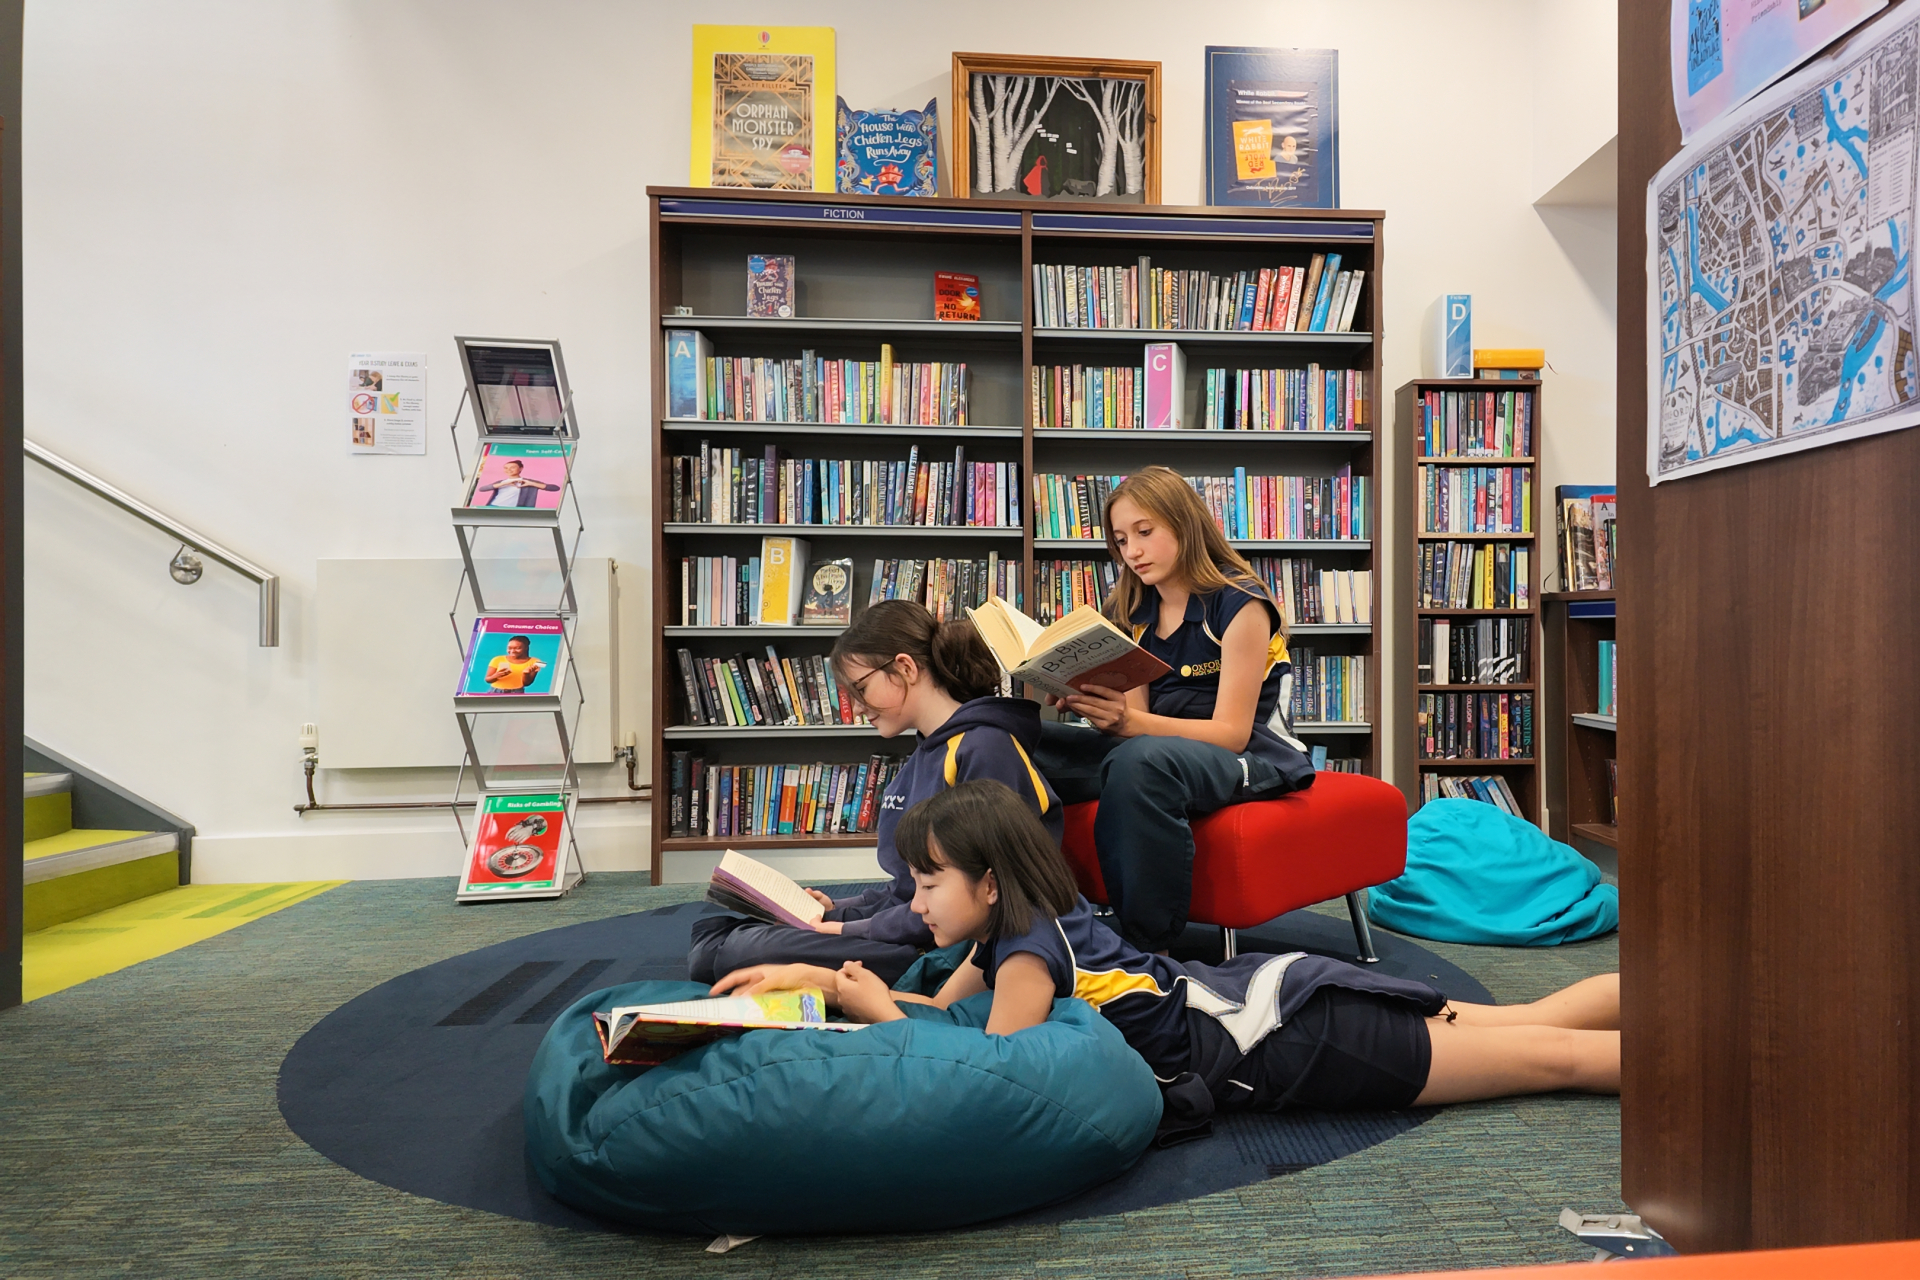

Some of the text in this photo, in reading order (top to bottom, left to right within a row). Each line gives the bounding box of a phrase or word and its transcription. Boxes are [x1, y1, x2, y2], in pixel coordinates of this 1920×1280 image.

[736, 103, 788, 119] ORPHAN
[732, 119, 794, 136] MONSTER
[752, 137, 773, 150] SPY
[1238, 142, 1270, 150] RABBIT
[1240, 135, 1268, 144] WHITE
[824, 208, 864, 220] FICTION
[938, 288, 960, 297] DOOR
[1246, 287, 1255, 308] LUCAS
[938, 311, 976, 320] RETURN
[1452, 303, 1466, 320] D
[674, 340, 691, 358] A
[1152, 354, 1167, 372] C
[908, 466, 916, 494] ATKINSON
[770, 547, 785, 565] B
[1041, 634, 1117, 673] Bryson
[1055, 637, 1087, 655] Bill
[836, 773, 846, 805] WINTERKILL
